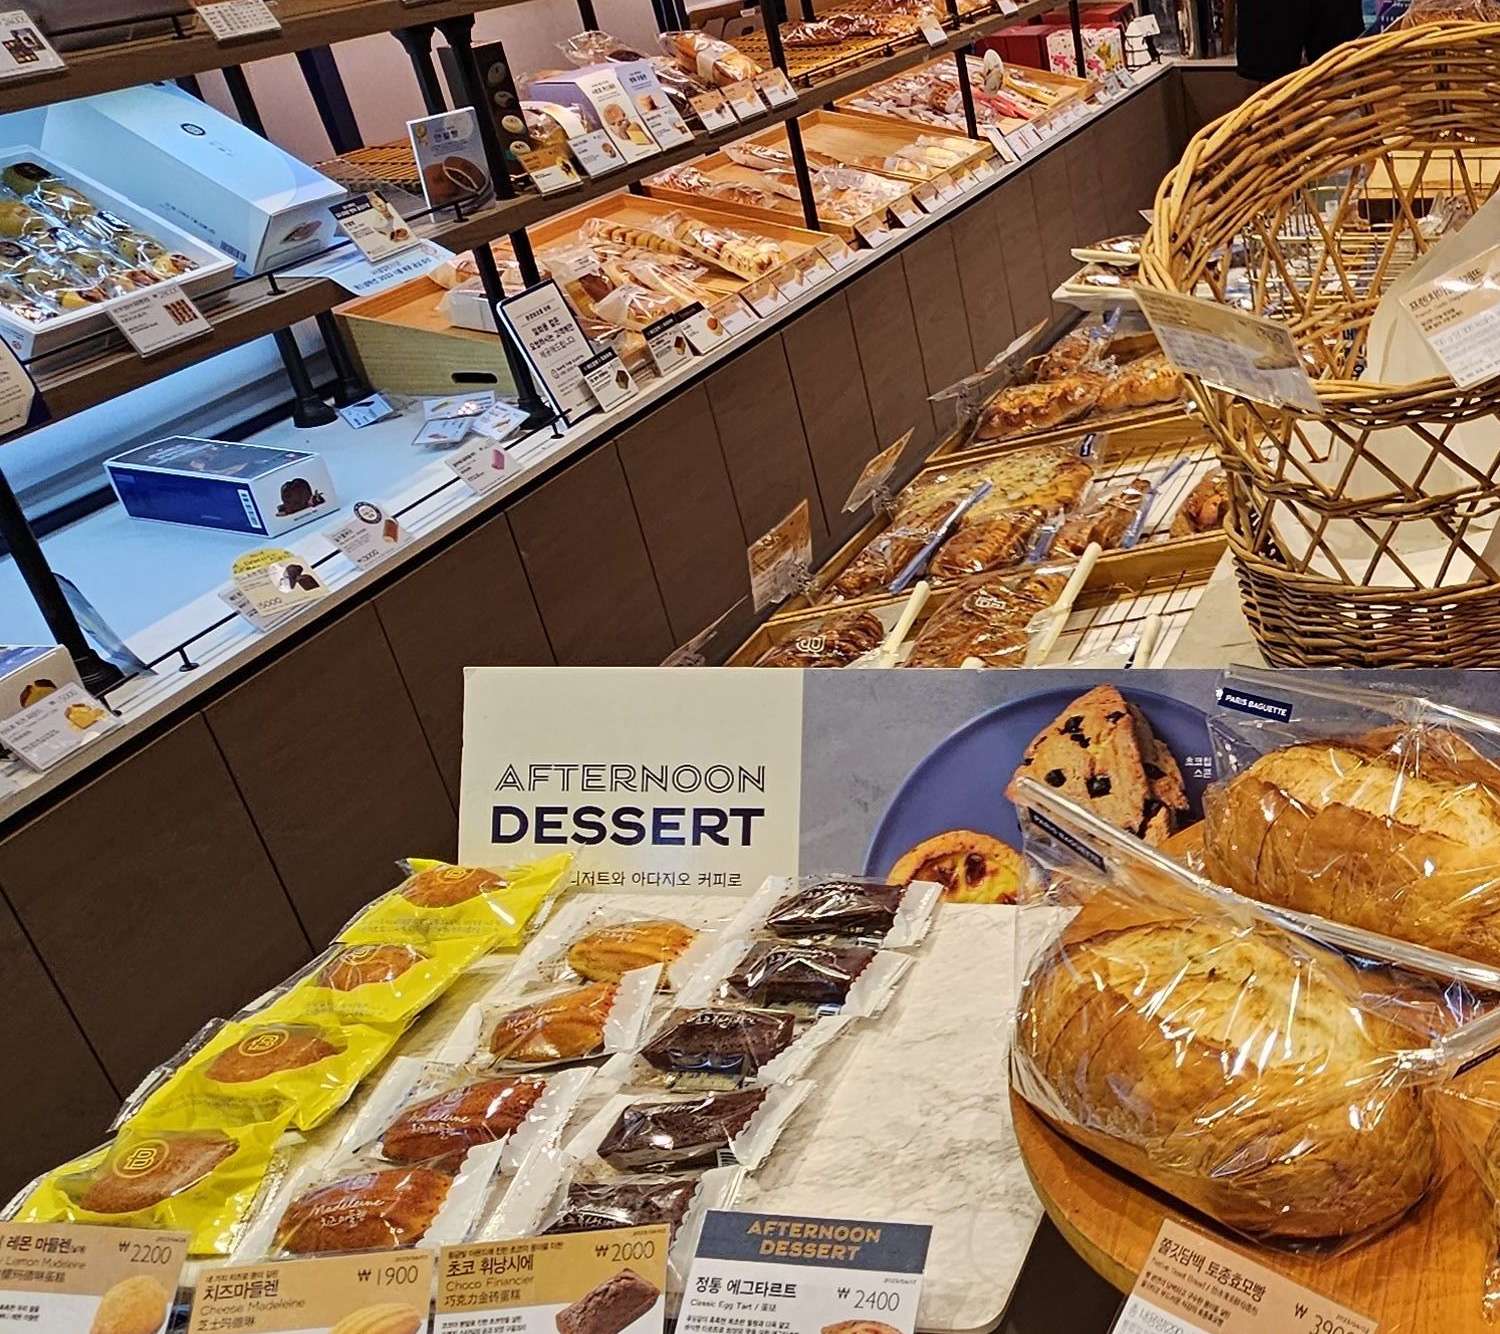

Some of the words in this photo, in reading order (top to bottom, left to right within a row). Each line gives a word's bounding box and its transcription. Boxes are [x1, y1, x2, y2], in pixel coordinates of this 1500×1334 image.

[1225, 692, 1251, 708] PARIS
[1247, 697, 1289, 718] BAGUETTE
[494, 763, 766, 793] AFTERNOON
[490, 806, 766, 846] DESSERT
[631, 871, 691, 888] 아다지오
[698, 871, 743, 888] 커피로
[306, 1198, 386, 1218] Madeleine
[746, 1221, 881, 1243] AFTERNOON
[6, 1236, 32, 1252] 레몬
[35, 1237, 72, 1253] 마들렌
[130, 1244, 172, 1264] 2200
[611, 1240, 655, 1262] 2000
[759, 1240, 861, 1261] DESSERT
[378, 1266, 418, 1285] 1900
[444, 1259, 475, 1277] 초코
[478, 1253, 534, 1275] 휘낭시에
[1155, 1235, 1207, 1273] 쫄깃담백
[1202, 1260, 1268, 1304] 토종효모빵
[202, 1278, 280, 1302] 치즈마들렌
[445, 1278, 482, 1292] Choco
[485, 1272, 535, 1288] Financier
[696, 1276, 722, 1292] 정통
[727, 1280, 797, 1299] 에그타르트
[200, 1302, 244, 1317] Cheese
[248, 1296, 306, 1312] Madeleine
[854, 1289, 900, 1312] 2400
